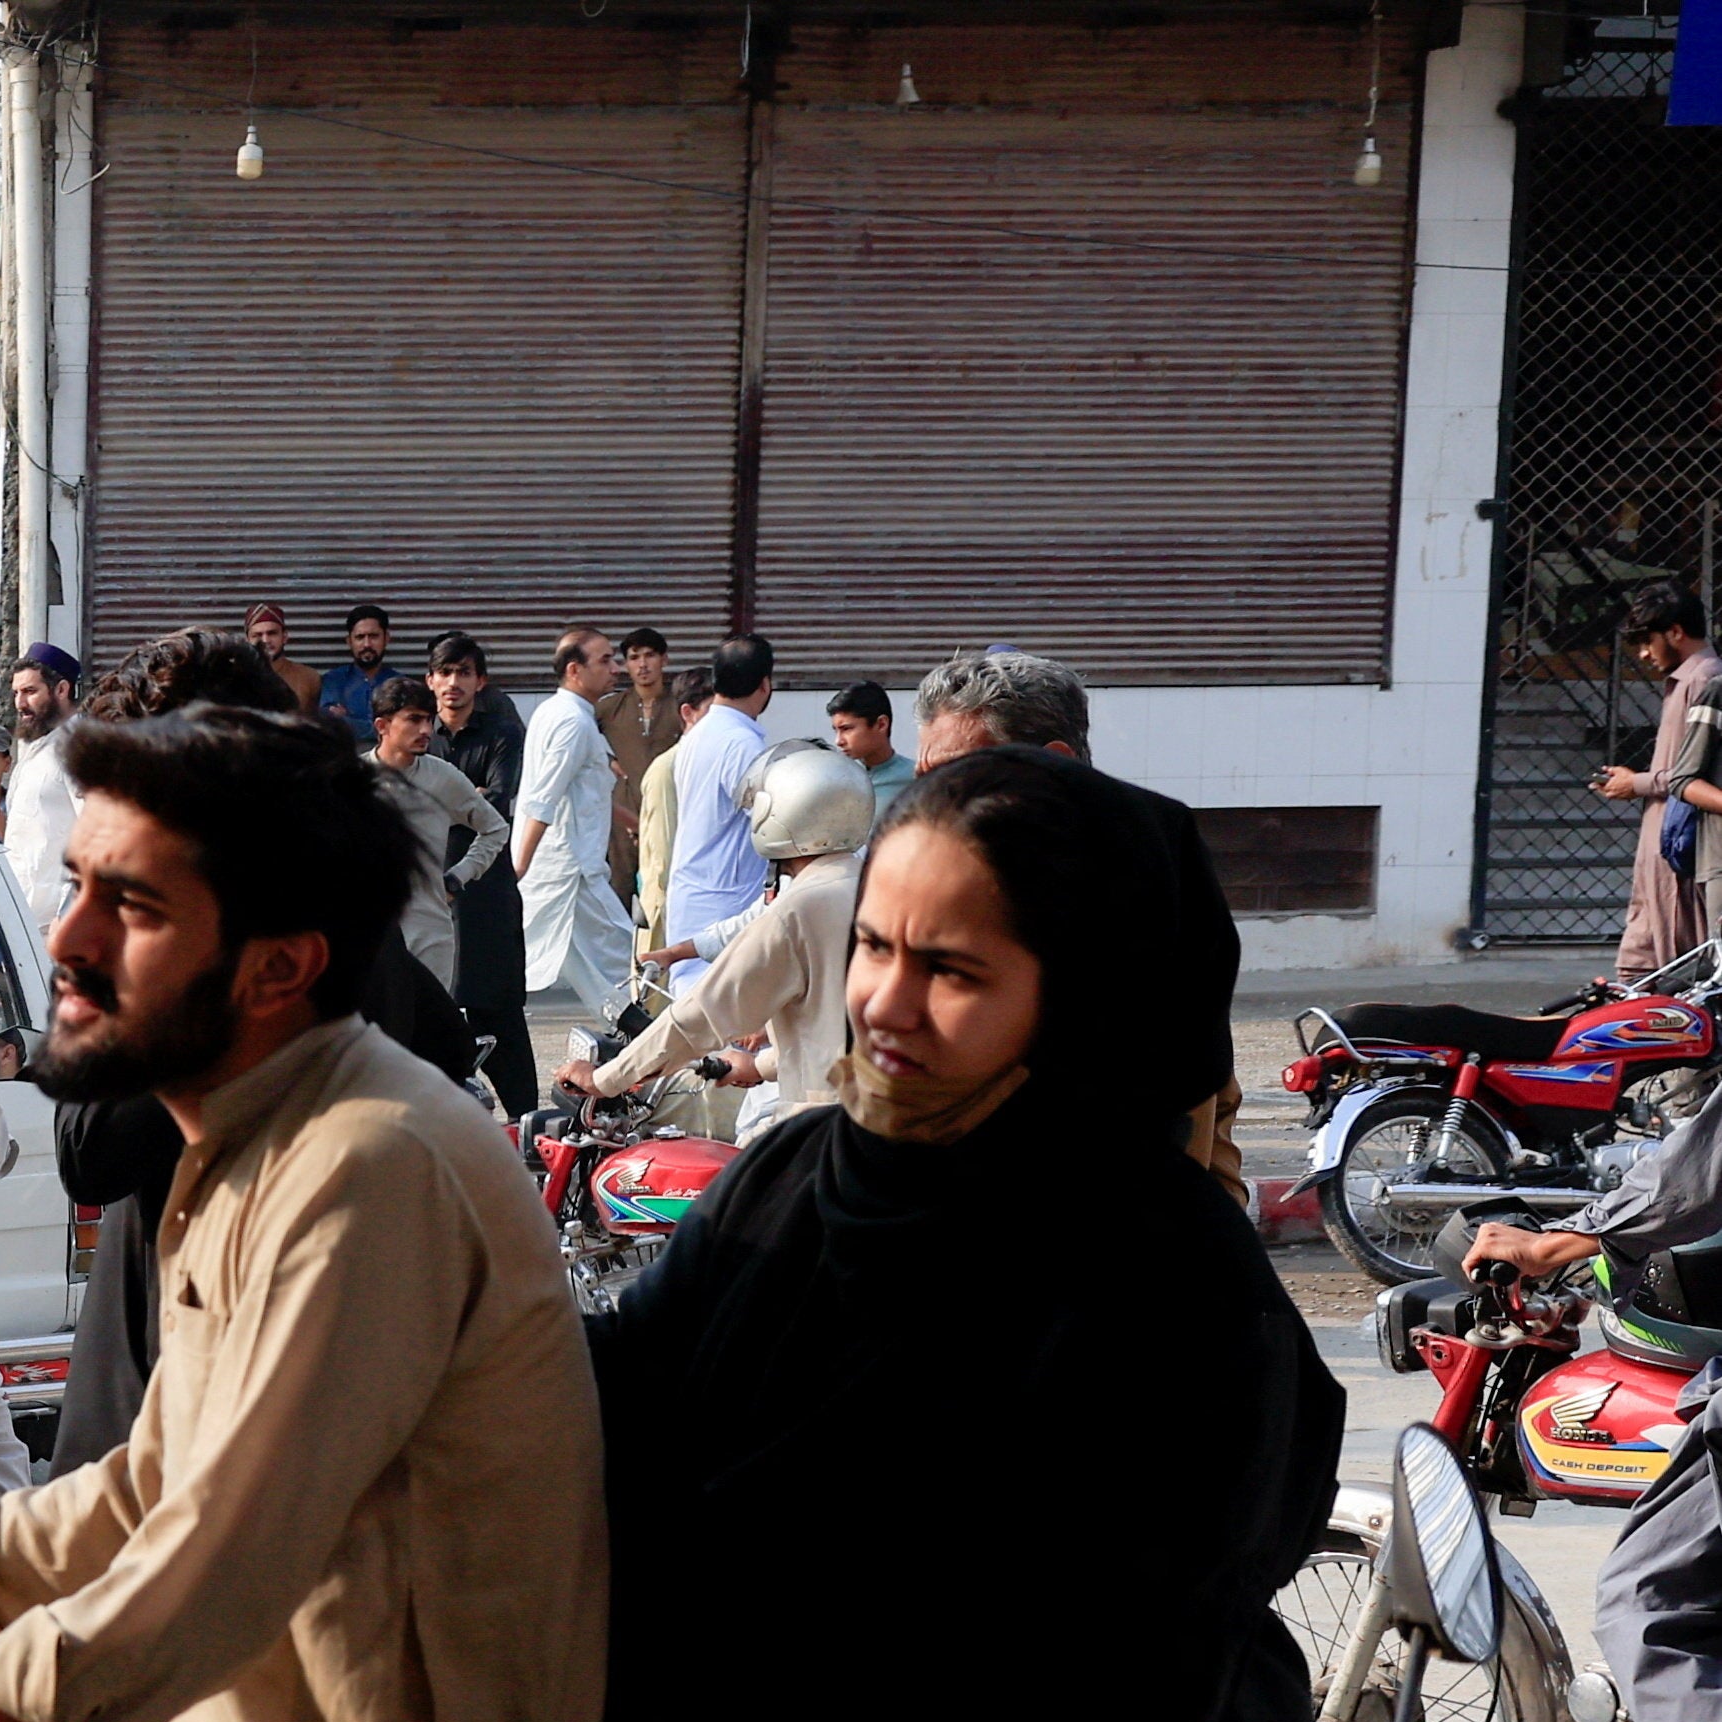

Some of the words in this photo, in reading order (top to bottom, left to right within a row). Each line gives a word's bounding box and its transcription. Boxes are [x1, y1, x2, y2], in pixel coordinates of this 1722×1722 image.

[1551, 1427, 1610, 1443] HONDA
[1552, 1458, 1583, 1469] CASH
[1586, 1463, 1649, 1474] DEPOSIT
